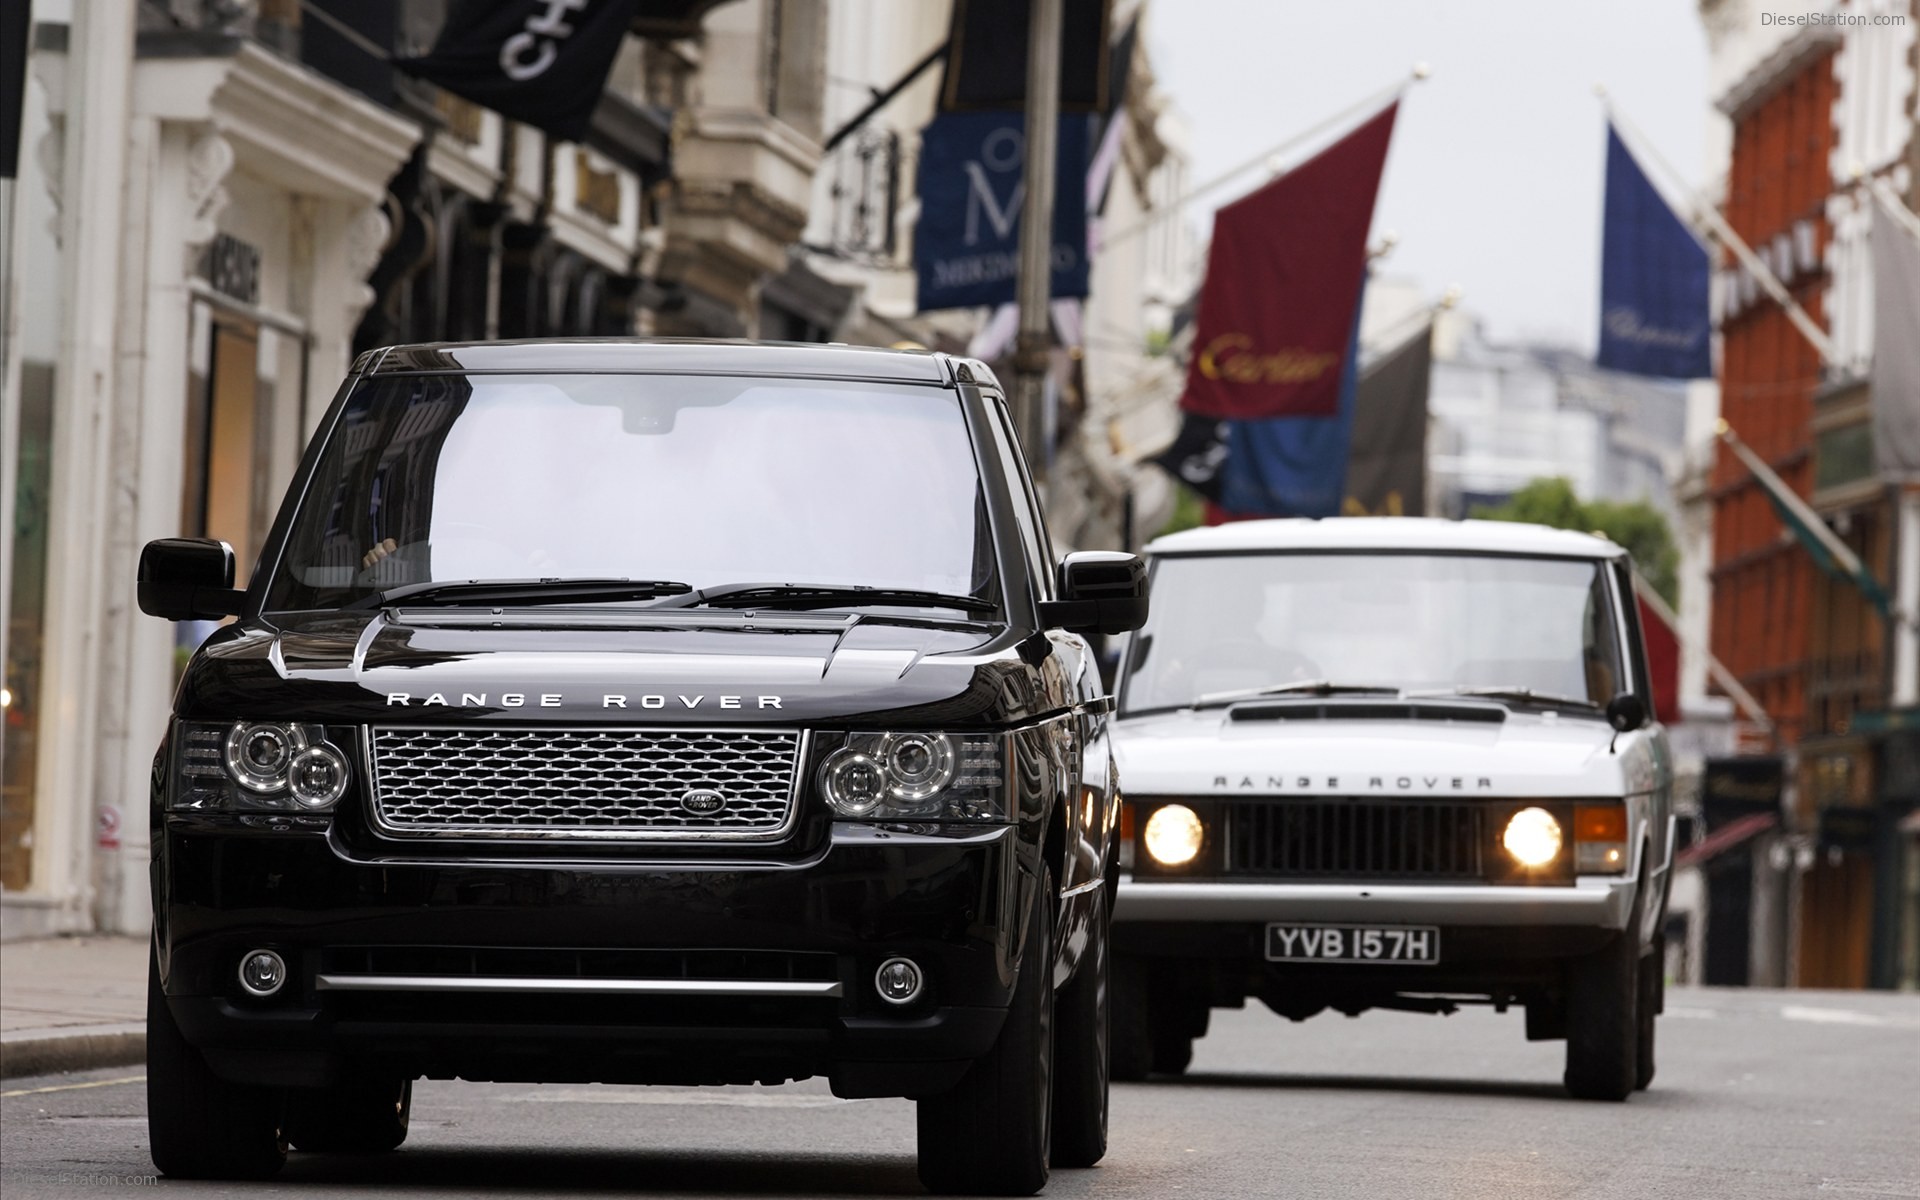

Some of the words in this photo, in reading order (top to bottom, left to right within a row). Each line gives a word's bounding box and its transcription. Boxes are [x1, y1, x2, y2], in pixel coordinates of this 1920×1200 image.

[1199, 331, 1338, 385] Cartier
[385, 691, 563, 709] RANGE
[602, 693, 784, 710] ROVER
[1213, 775, 1340, 790] RANGE
[1368, 776, 1493, 791] ROVER
[1277, 928, 1345, 958] YVB
[1352, 929, 1429, 960] 157H
